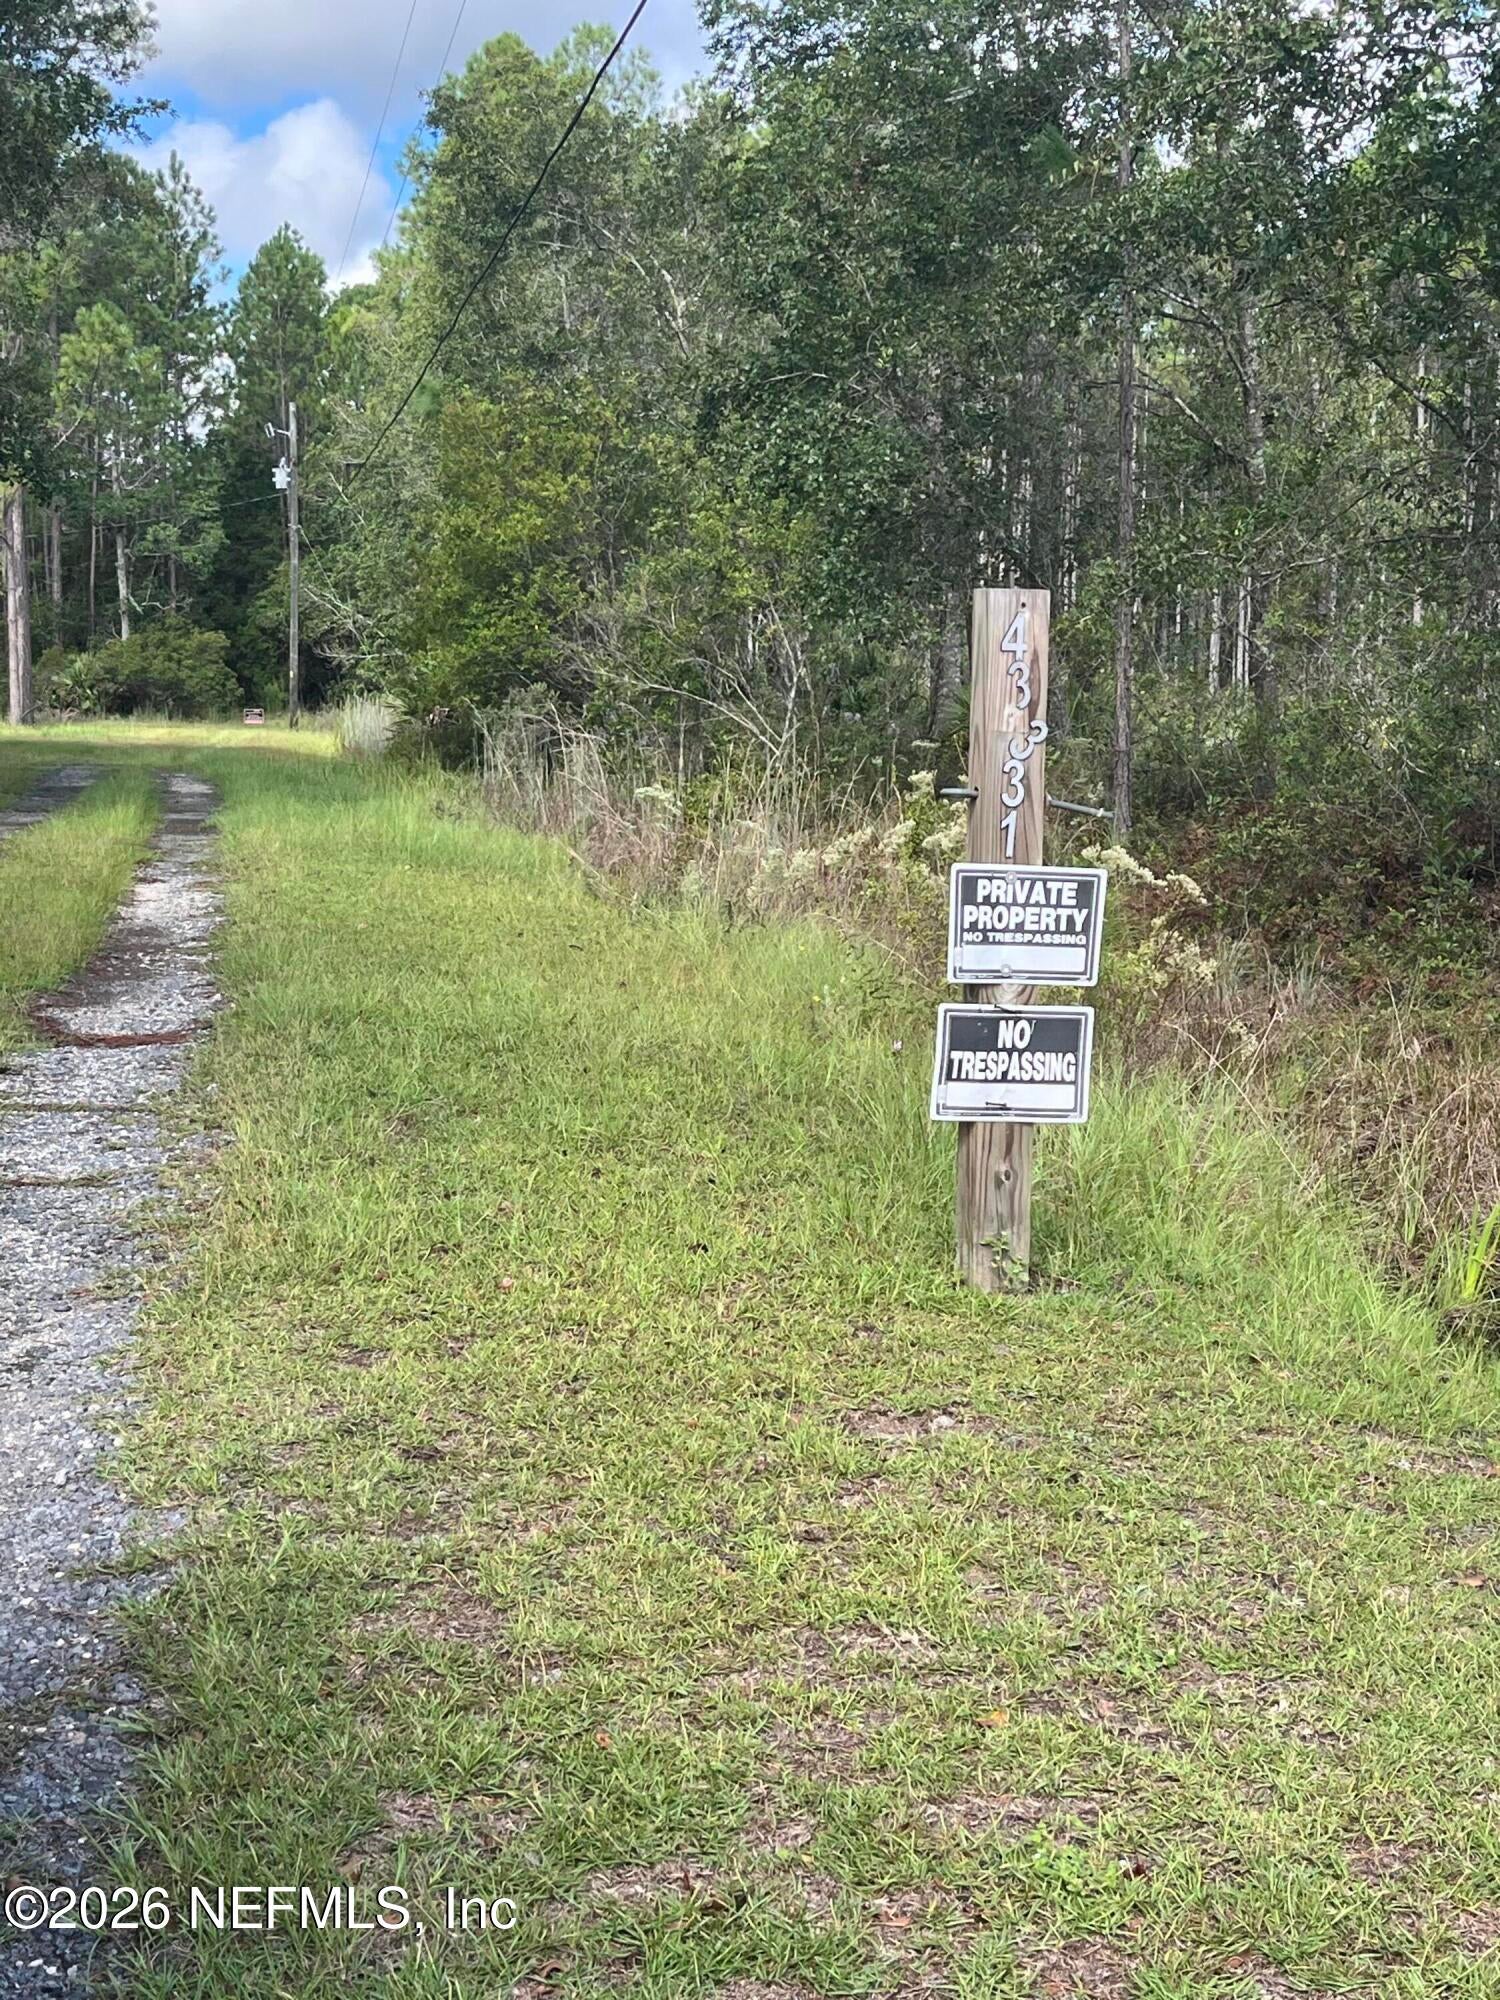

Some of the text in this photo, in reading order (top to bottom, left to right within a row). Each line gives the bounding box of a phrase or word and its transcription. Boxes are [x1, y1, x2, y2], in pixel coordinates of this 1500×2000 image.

[1001, 611, 1049, 859] 43331
[976, 878, 1078, 906] PRIVATE
[963, 904, 1089, 932] PROPERTY
[962, 931, 1087, 945] NO TRESPASSING
[997, 1019, 1031, 1049] NO
[950, 1050, 1076, 1082] TRESPASSING
